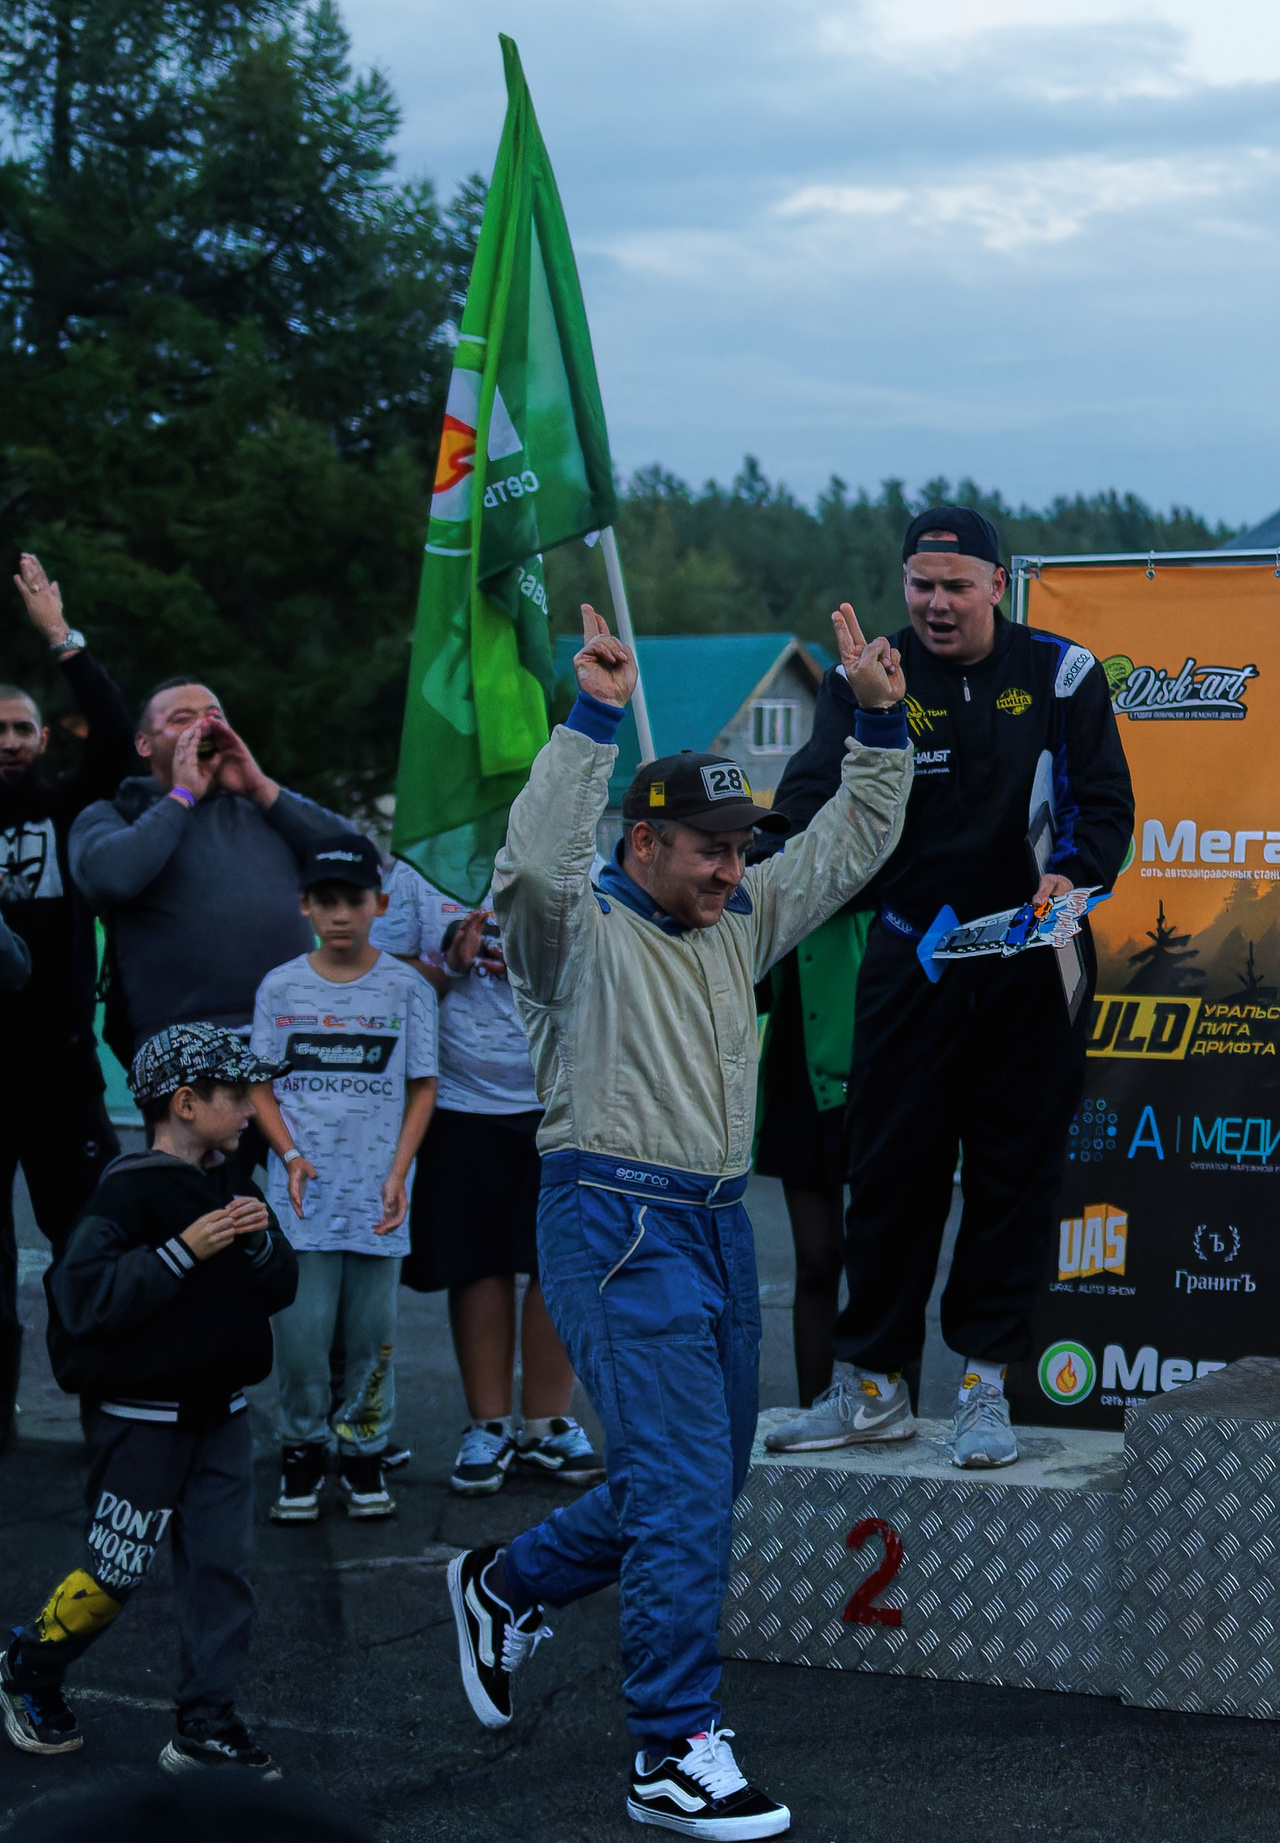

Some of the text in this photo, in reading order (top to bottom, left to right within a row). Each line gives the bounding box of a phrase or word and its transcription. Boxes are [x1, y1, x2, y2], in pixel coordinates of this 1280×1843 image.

[1062, 653, 1091, 688] sparco
[1118, 657, 1258, 709] Disk-art
[709, 768, 742, 792] 28
[1197, 1021, 1251, 1036] ЛИГА
[1191, 1040, 1276, 1055] ДРИФТА
[283, 1075, 393, 1096] АВТОКРОСС
[615, 1166, 670, 1188] sparco
[1059, 1214, 1128, 1275] UAS
[1175, 1269, 1257, 1294] ГранитЪ
[1102, 1344, 1228, 1393] Мег
[94, 1490, 174, 1543] DON'T
[88, 1521, 157, 1575] WORRY
[842, 1517, 903, 1627] 2
